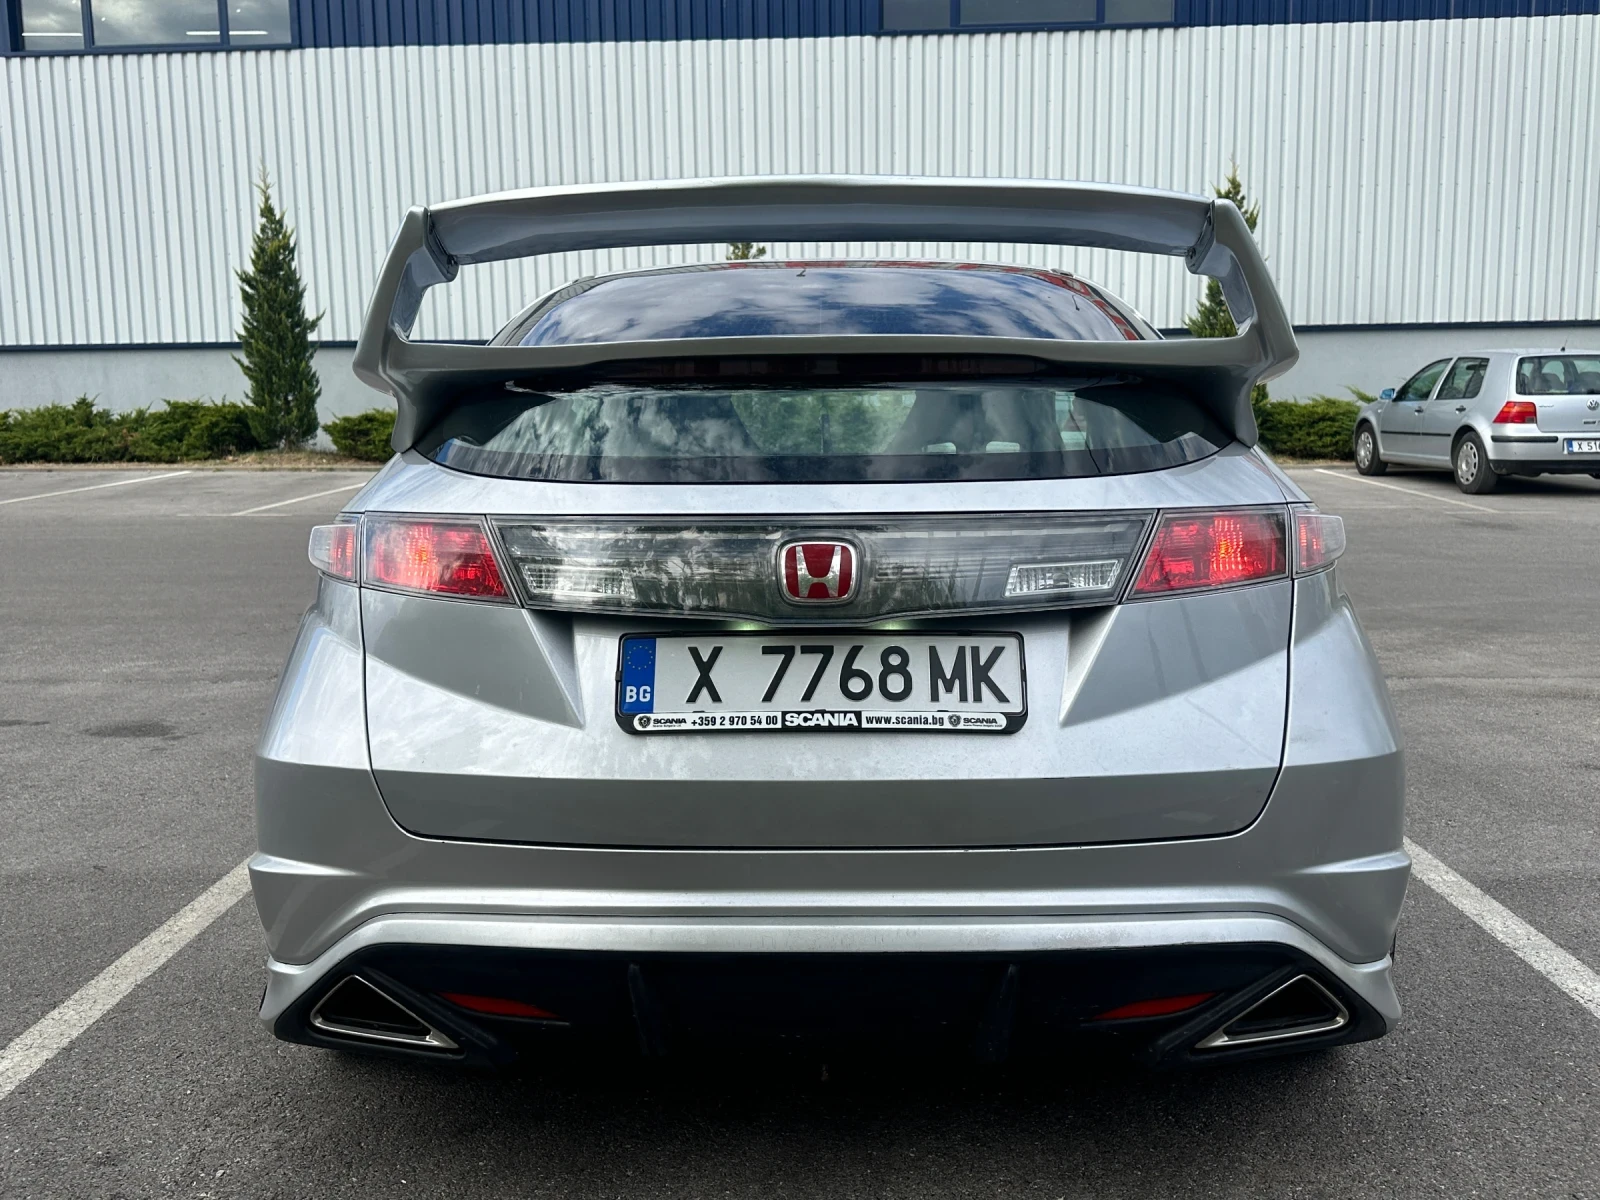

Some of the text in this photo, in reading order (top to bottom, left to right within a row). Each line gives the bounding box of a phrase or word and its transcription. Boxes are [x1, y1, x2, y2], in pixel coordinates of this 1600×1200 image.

[1577, 442, 1583, 451] X
[686, 645, 1010, 703] X 7768 MK
[625, 686, 651, 702] BG
[691, 715, 778, 726] +359 2 970 54 00
[785, 713, 858, 726] SCANIA
[865, 715, 944, 726] www.scania.bg
[963, 717, 998, 725] SCANIA
